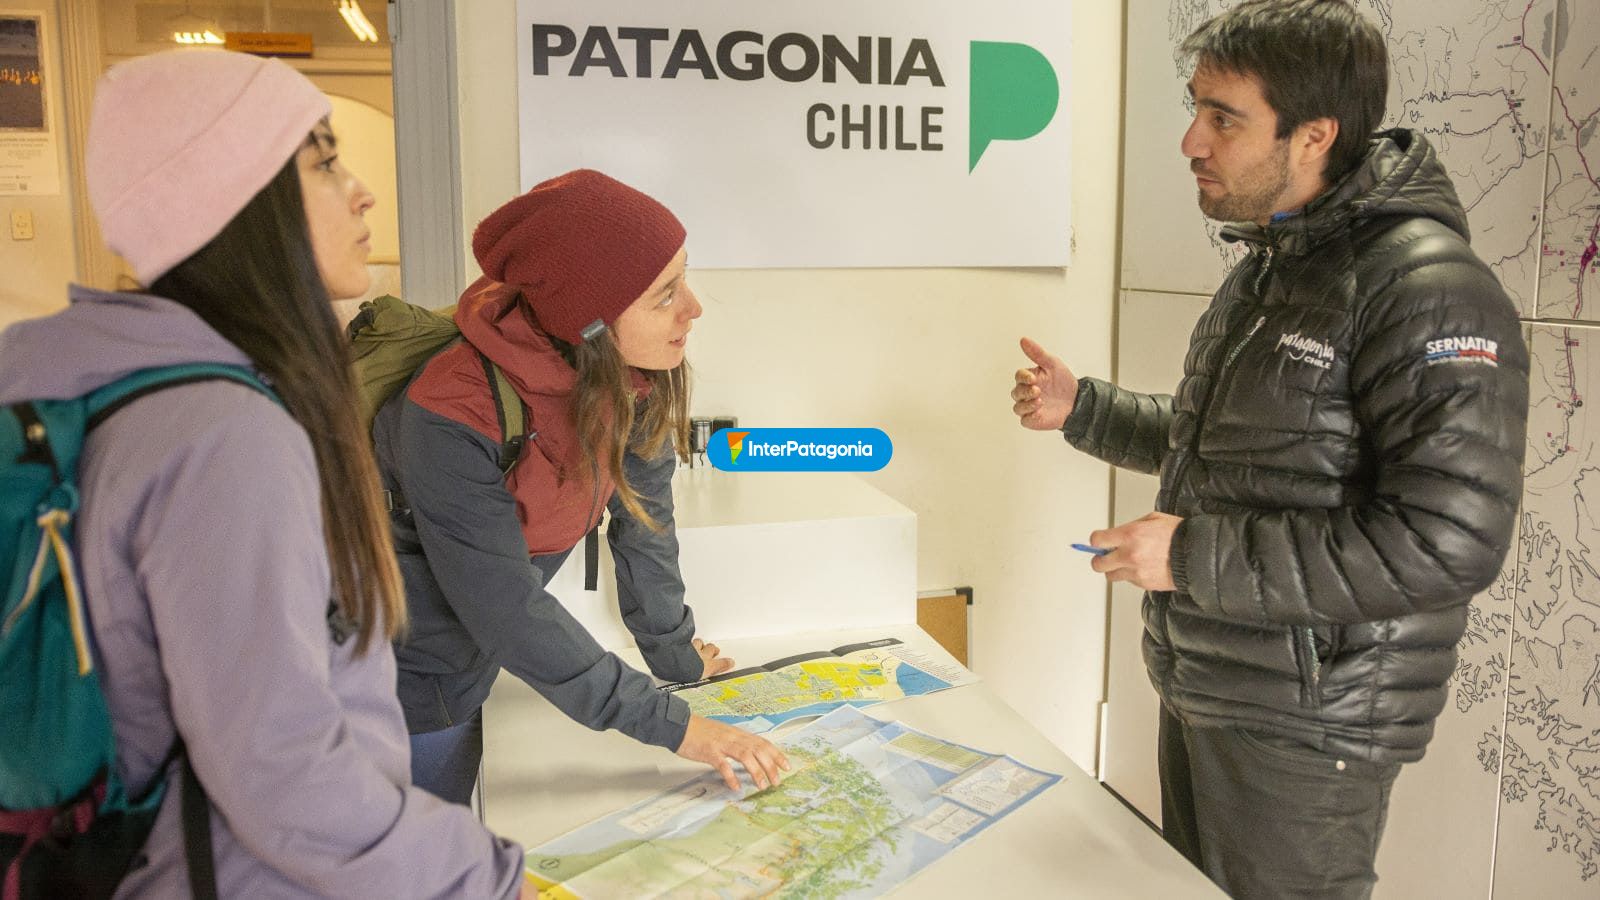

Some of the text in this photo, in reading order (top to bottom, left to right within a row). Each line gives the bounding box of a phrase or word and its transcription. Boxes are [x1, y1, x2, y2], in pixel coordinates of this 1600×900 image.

[532, 24, 945, 87] PATAGONIA
[806, 103, 944, 151] CHILE
[1274, 331, 1335, 361] patagonia
[1426, 336, 1498, 355] SERNATUR
[1304, 355, 1332, 369] CHILE
